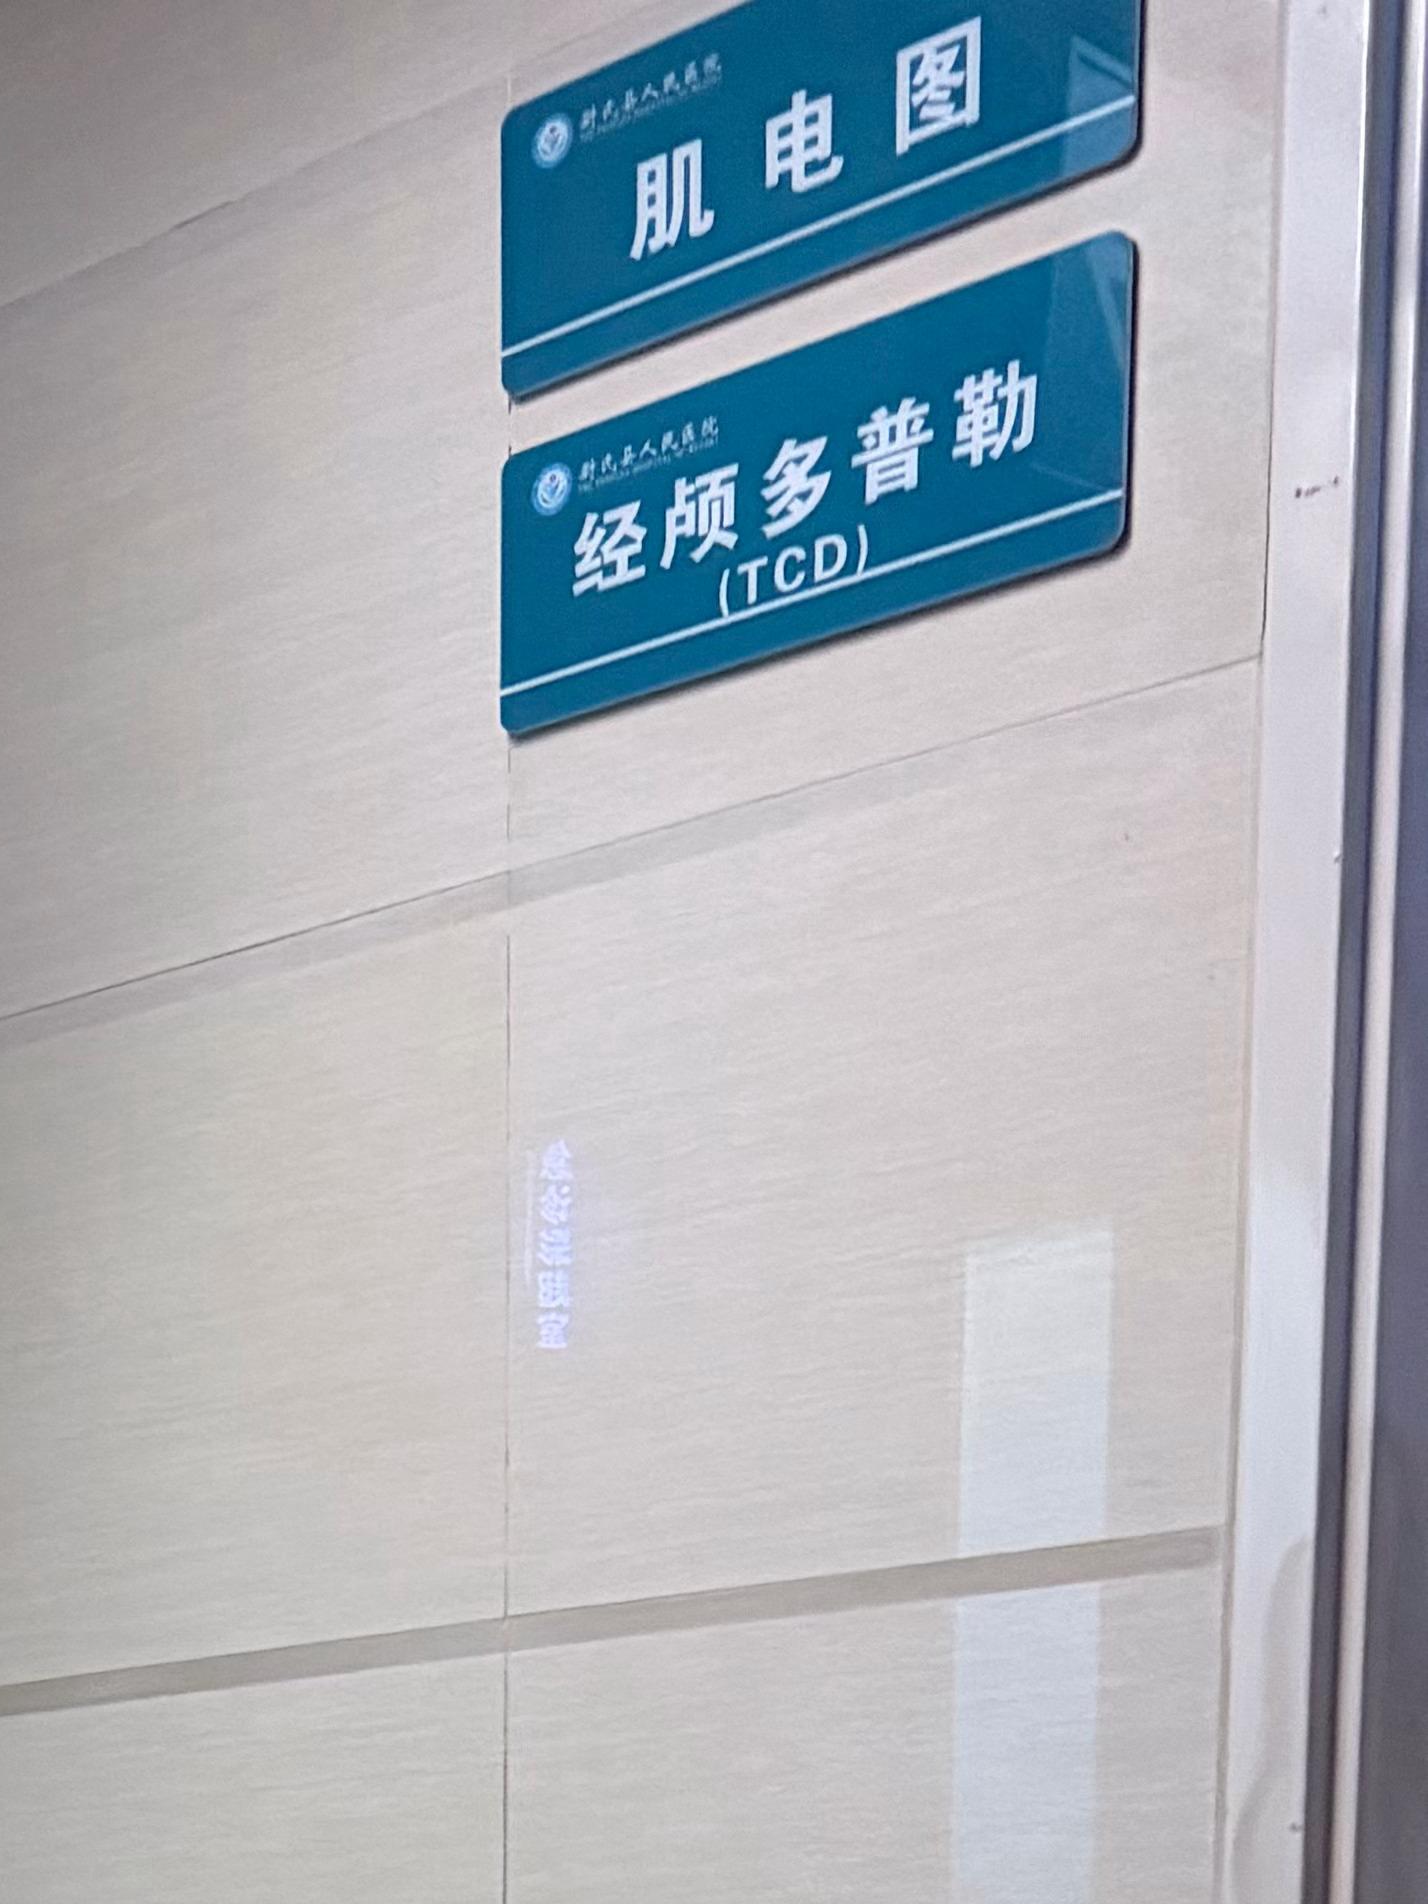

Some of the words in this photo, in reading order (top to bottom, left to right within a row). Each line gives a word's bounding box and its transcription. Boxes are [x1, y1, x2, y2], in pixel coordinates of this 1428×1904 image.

[629, 16, 982, 262] 肌电图
[572, 359, 1038, 597] 经颅多普勒
[719, 524, 869, 618] (TCD)
